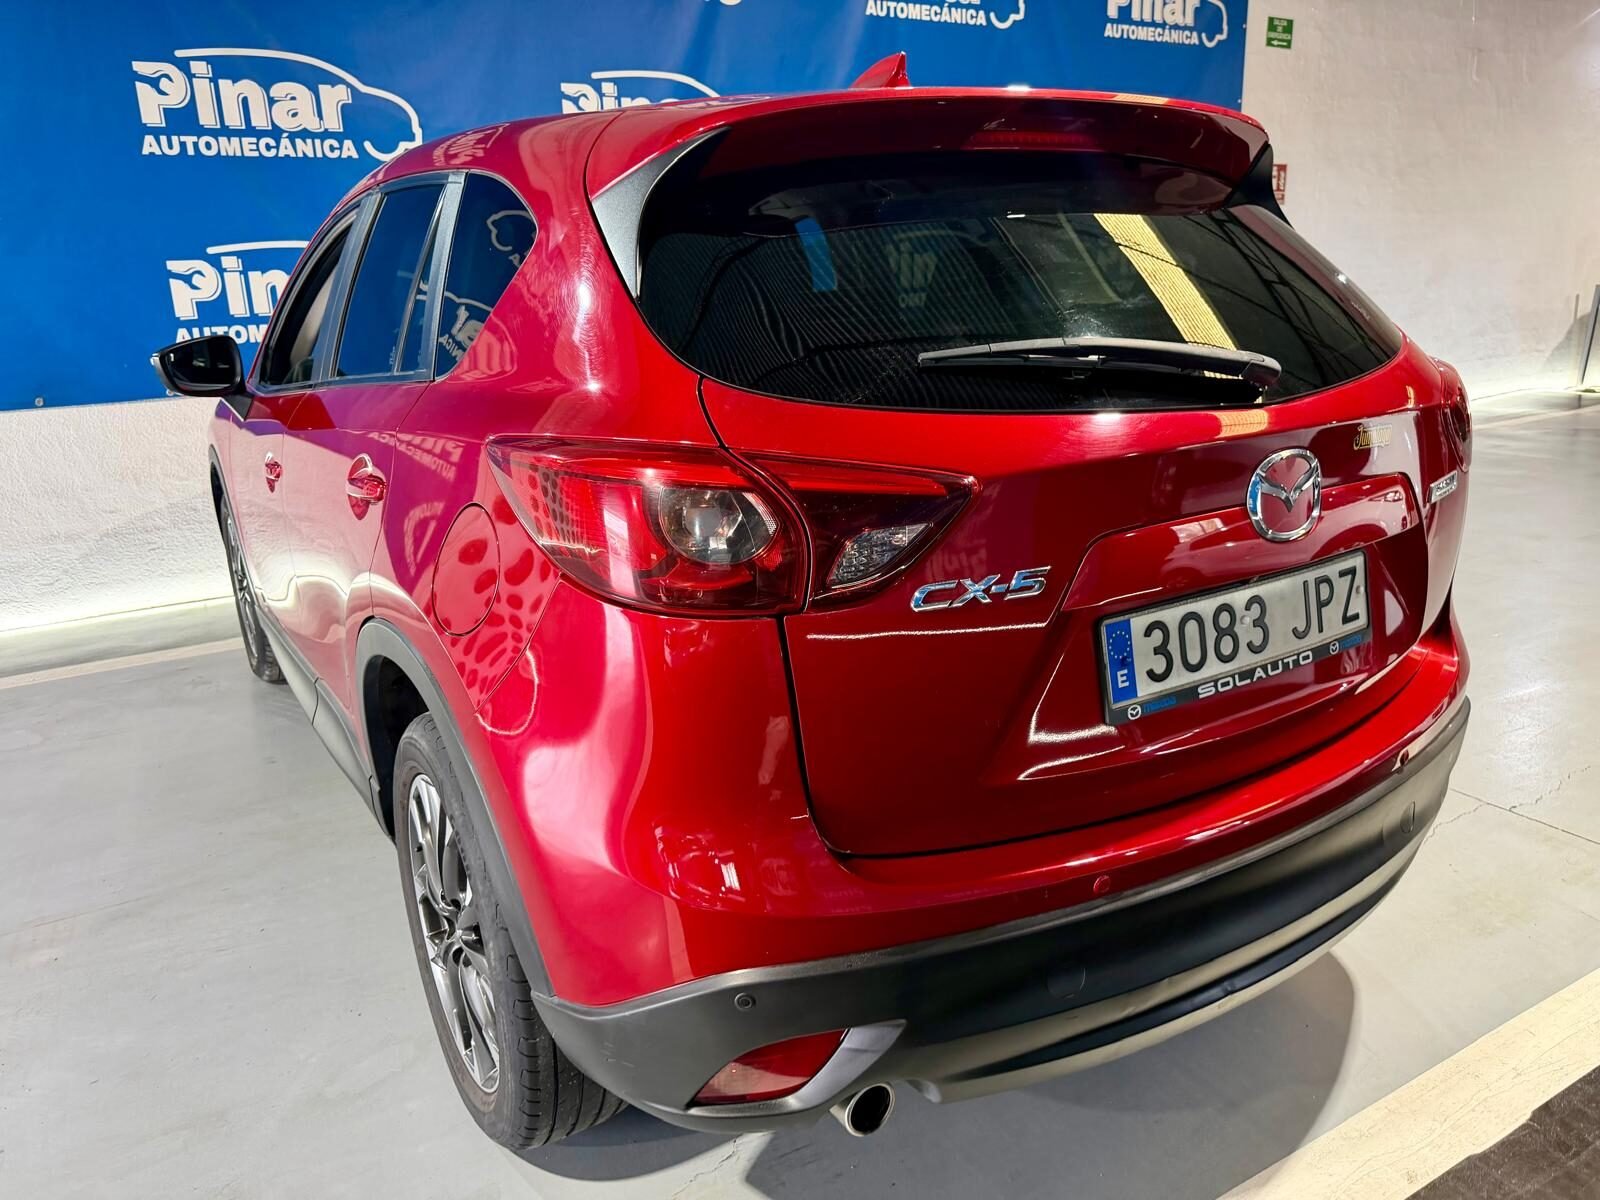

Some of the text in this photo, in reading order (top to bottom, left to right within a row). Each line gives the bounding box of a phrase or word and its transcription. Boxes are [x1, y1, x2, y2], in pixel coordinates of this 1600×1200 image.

[866, 0, 987, 26] AUTOMECÁNICA
[1104, 23, 1199, 45] AUTOMECÁNICA
[132, 61, 352, 132] Pinar
[142, 133, 359, 158] AUTOMECÁNICA
[910, 566, 1051, 612] CX-5
[1144, 566, 1359, 682] 3083 JPZ
[1117, 669, 1129, 688] E
[1198, 650, 1313, 699] SOLAUTO
